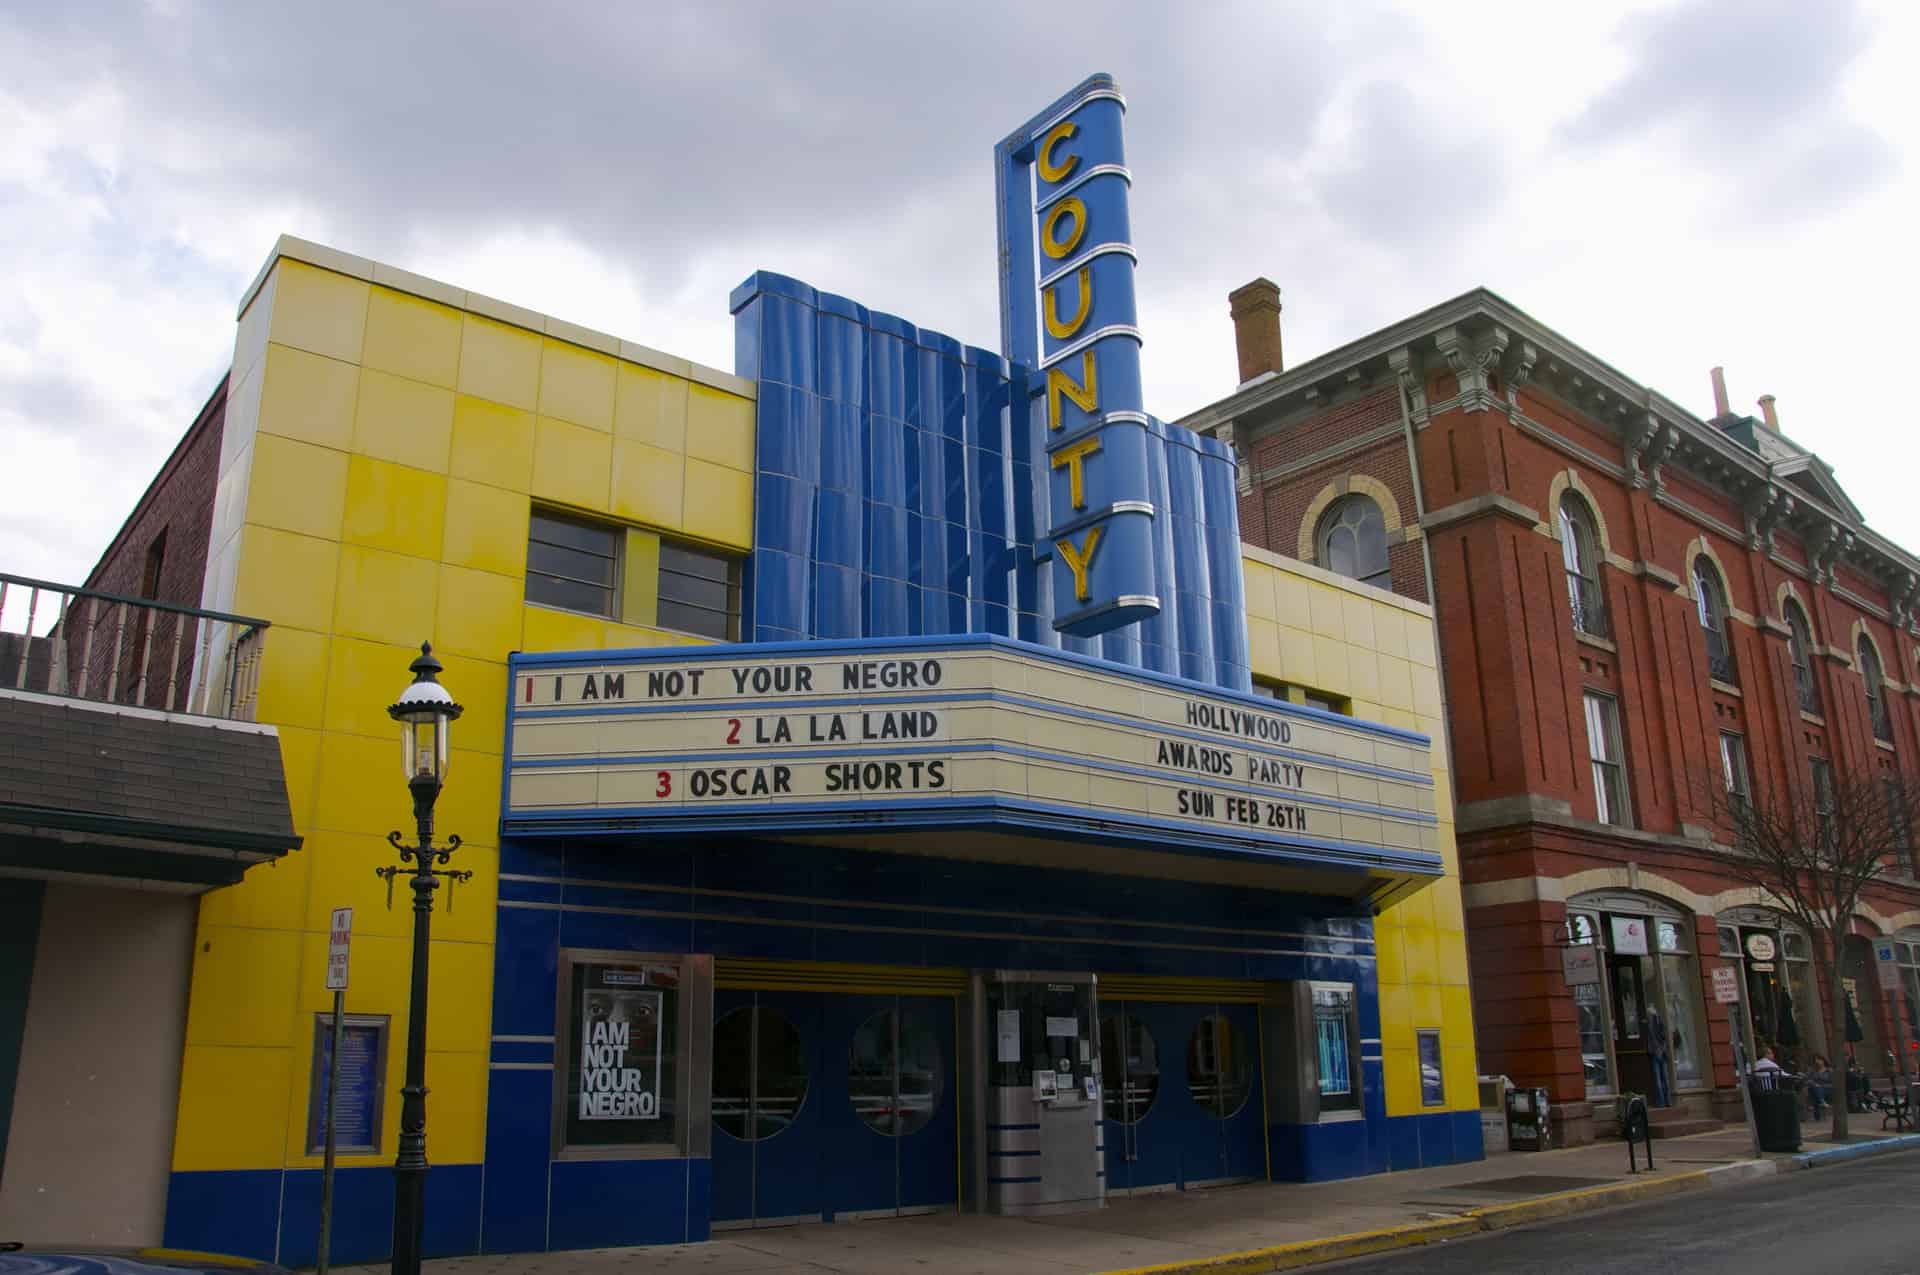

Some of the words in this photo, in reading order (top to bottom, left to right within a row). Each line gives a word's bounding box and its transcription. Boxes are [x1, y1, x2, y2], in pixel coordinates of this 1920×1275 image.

[1037, 121, 1103, 602] COUNTY
[581, 674, 625, 699] AM
[648, 670, 704, 697] NOT
[732, 666, 812, 694] YOUR
[843, 660, 942, 690] NEGRO
[726, 719, 741, 745] 2
[756, 717, 792, 743] LA
[810, 714, 846, 741] LA
[862, 712, 938, 740] LAND
[1186, 701, 1291, 744] HOLLYWOOD
[655, 771, 672, 798] 3
[690, 766, 792, 797] OSCAR
[825, 760, 945, 791] SHORTS
[1157, 740, 1233, 776] AWARDS
[1249, 758, 1304, 788] PARTY
[1177, 789, 1214, 818] SUN
[1226, 797, 1260, 824] FEB
[1267, 804, 1307, 831] 26TH
[592, 1022, 630, 1044] AM
[584, 1045, 629, 1068] NOT
[583, 1068, 642, 1092] YOUR
[581, 1092, 655, 1116] NEGRO
